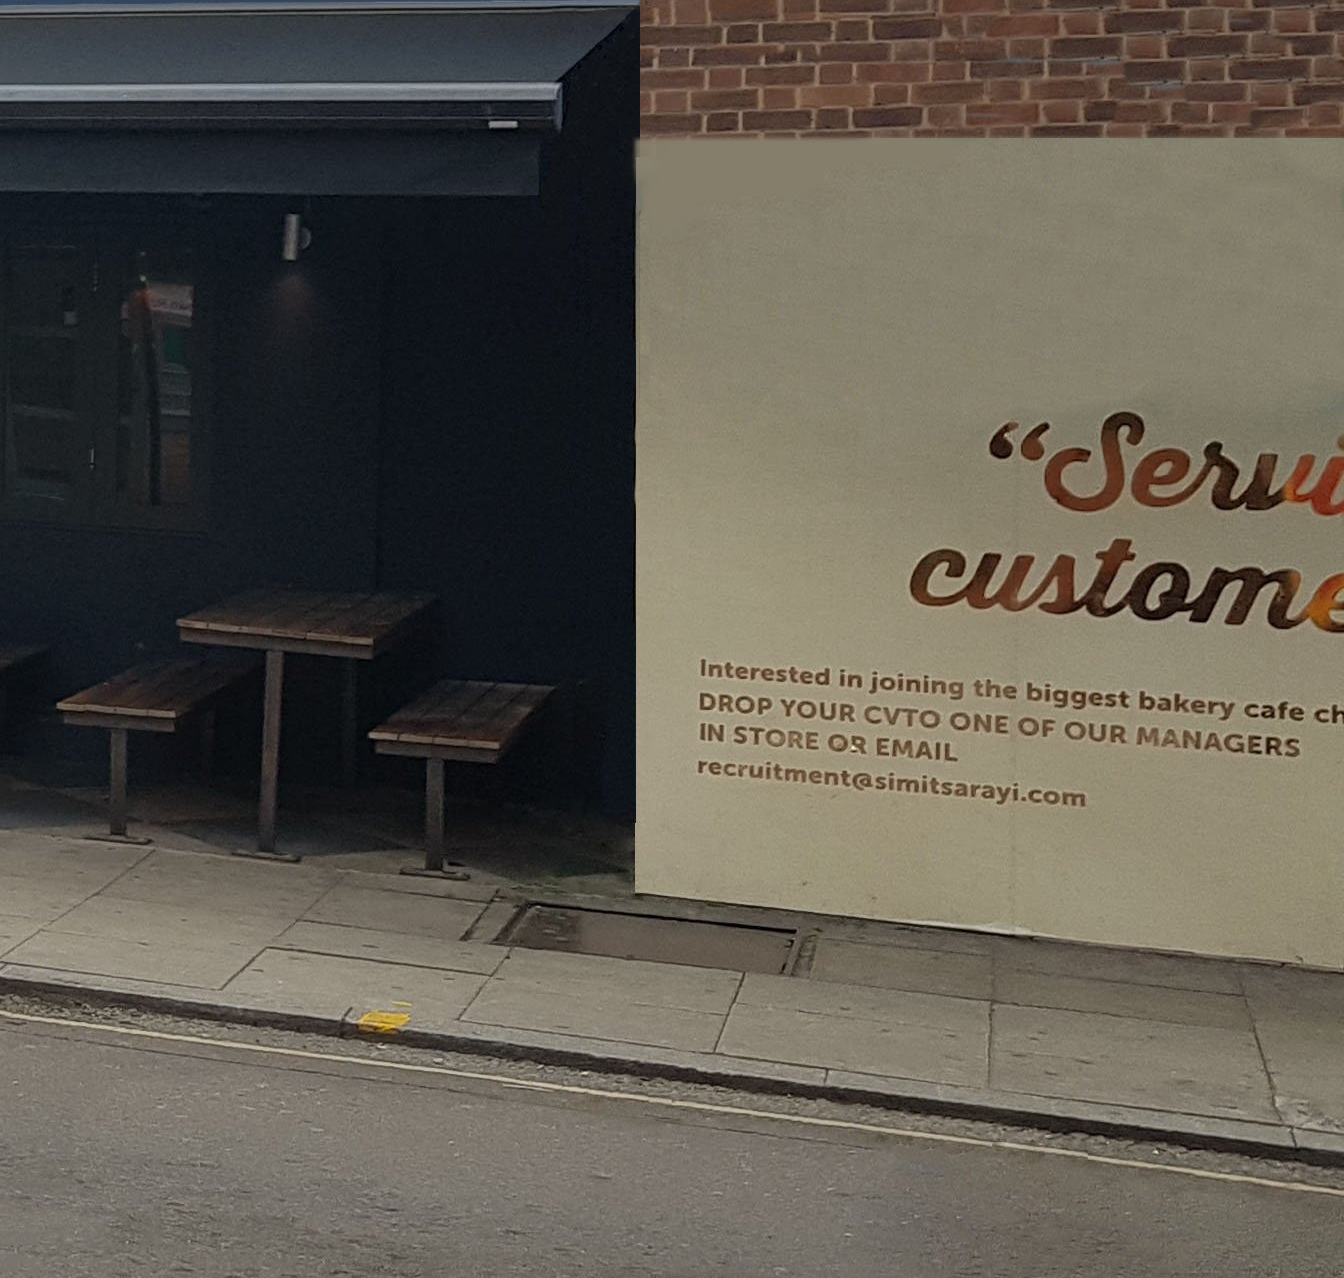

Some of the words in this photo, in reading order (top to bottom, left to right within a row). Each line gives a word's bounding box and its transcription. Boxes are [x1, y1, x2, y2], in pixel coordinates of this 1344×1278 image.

[699, 658, 831, 686] Interested
[839, 669, 863, 689] in
[868, 671, 964, 700] joining
[973, 678, 1018, 700] the
[1026, 681, 1130, 709] biggest
[1139, 690, 1235, 720] bakery
[1243, 701, 1305, 722] cafe
[699, 692, 773, 716] DROP
[780, 698, 856, 723] YOUR
[949, 711, 1010, 735] ONE
[1018, 716, 1057, 738] OF
[1064, 720, 1127, 745] OUR
[1136, 726, 1301, 758] MANAGERS
[699, 722, 725, 742] IN
[733, 726, 819, 751] STORE
[827, 733, 868, 755] OR
[876, 737, 959, 763] EMAIL
[697, 758, 1087, 808] recruitment@simitsarayi.com
